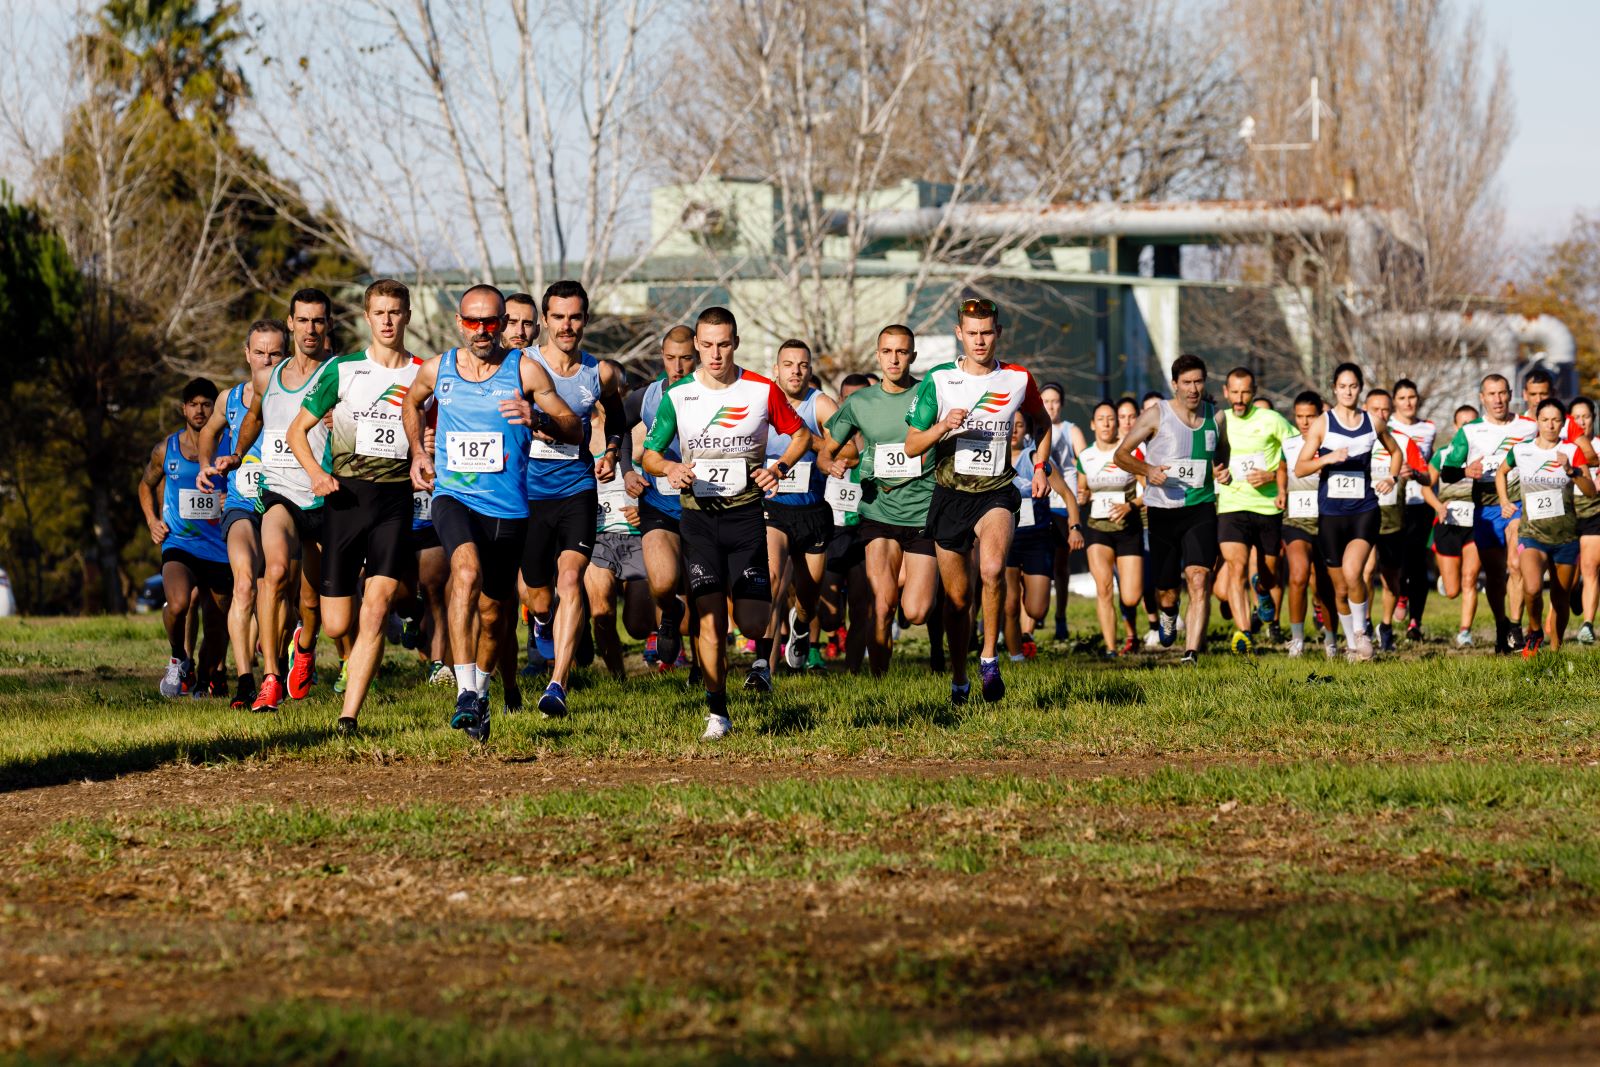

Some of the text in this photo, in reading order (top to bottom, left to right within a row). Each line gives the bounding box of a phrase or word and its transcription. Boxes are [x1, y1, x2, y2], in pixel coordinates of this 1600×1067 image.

[374, 428, 395, 444] 28
[688, 435, 752, 450] EXÉRCITO
[459, 441, 490, 458] 187
[887, 452, 905, 466] 30
[972, 449, 992, 463] 29
[708, 468, 729, 483] 27
[1178, 466, 1194, 478] 94
[1336, 478, 1356, 488] 121
[840, 489, 857, 501] 95
[189, 497, 214, 509] 188
[414, 497, 429, 509] 91
[1298, 498, 1311, 508] 14
[1537, 497, 1552, 508] 23
[1457, 508, 1469, 517] 24
